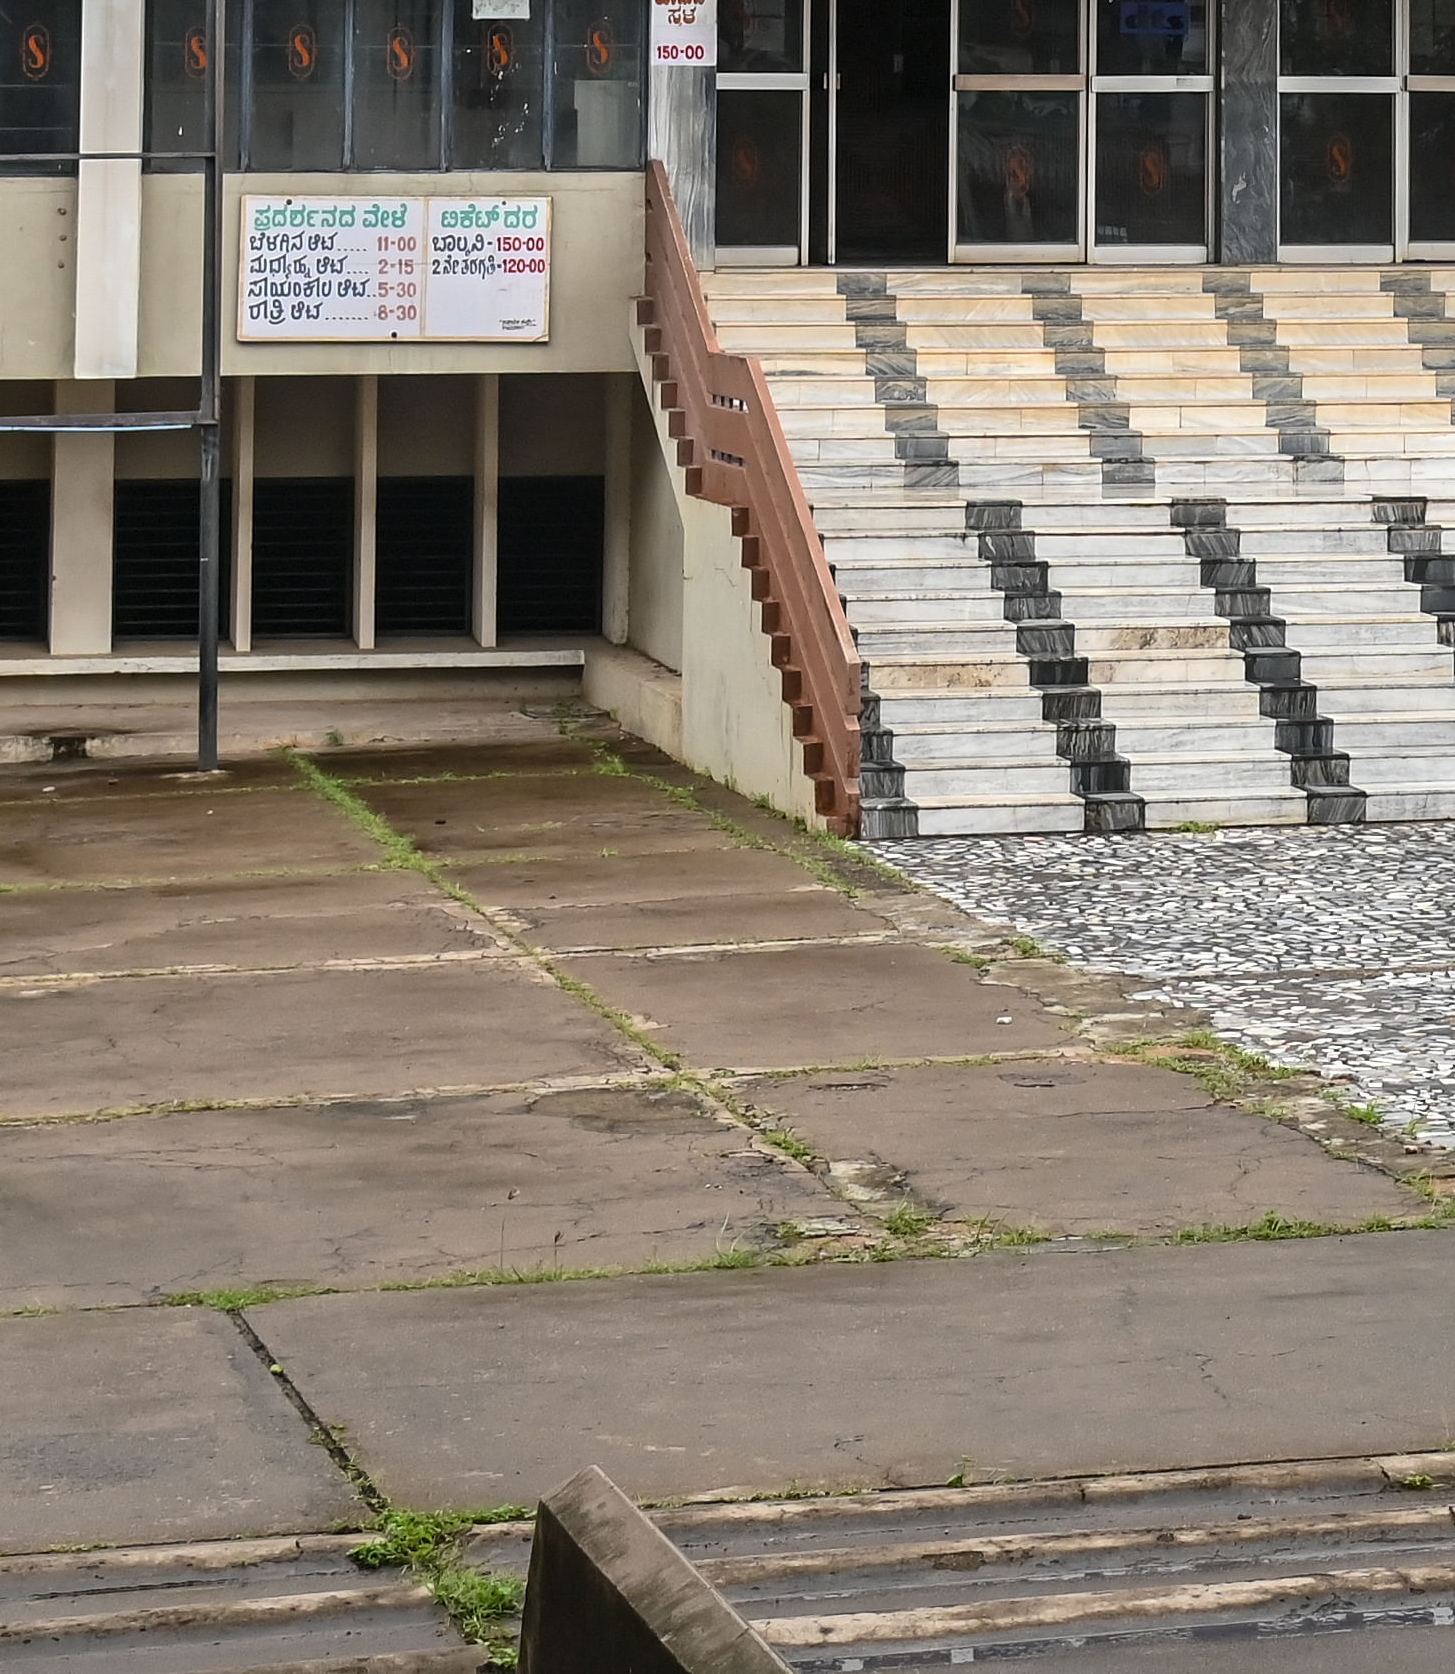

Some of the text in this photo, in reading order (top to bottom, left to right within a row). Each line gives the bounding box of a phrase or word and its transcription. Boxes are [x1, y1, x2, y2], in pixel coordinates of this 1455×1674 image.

[657, 45, 704, 60] 150-00
[253, 203, 408, 231] ಪ್ರದರ್ಶನದ ವೇಳೆ
[440, 203, 538, 229] ಟಿಕೆಟ್ ದರ
[249, 231, 305, 253] ಬೆಳಗಿನ
[377, 235, 417, 252] 11-00
[497, 236, 544, 252] 150-00
[378, 258, 415, 274] 2-15
[502, 258, 546, 274] 120-00
[247, 278, 332, 298] ಸಾಯಂಕಾಲ
[377, 282, 417, 298] 5-30
[248, 299, 287, 325] ರಾತ್ರಿ
[377, 304, 418, 321] 8-30
